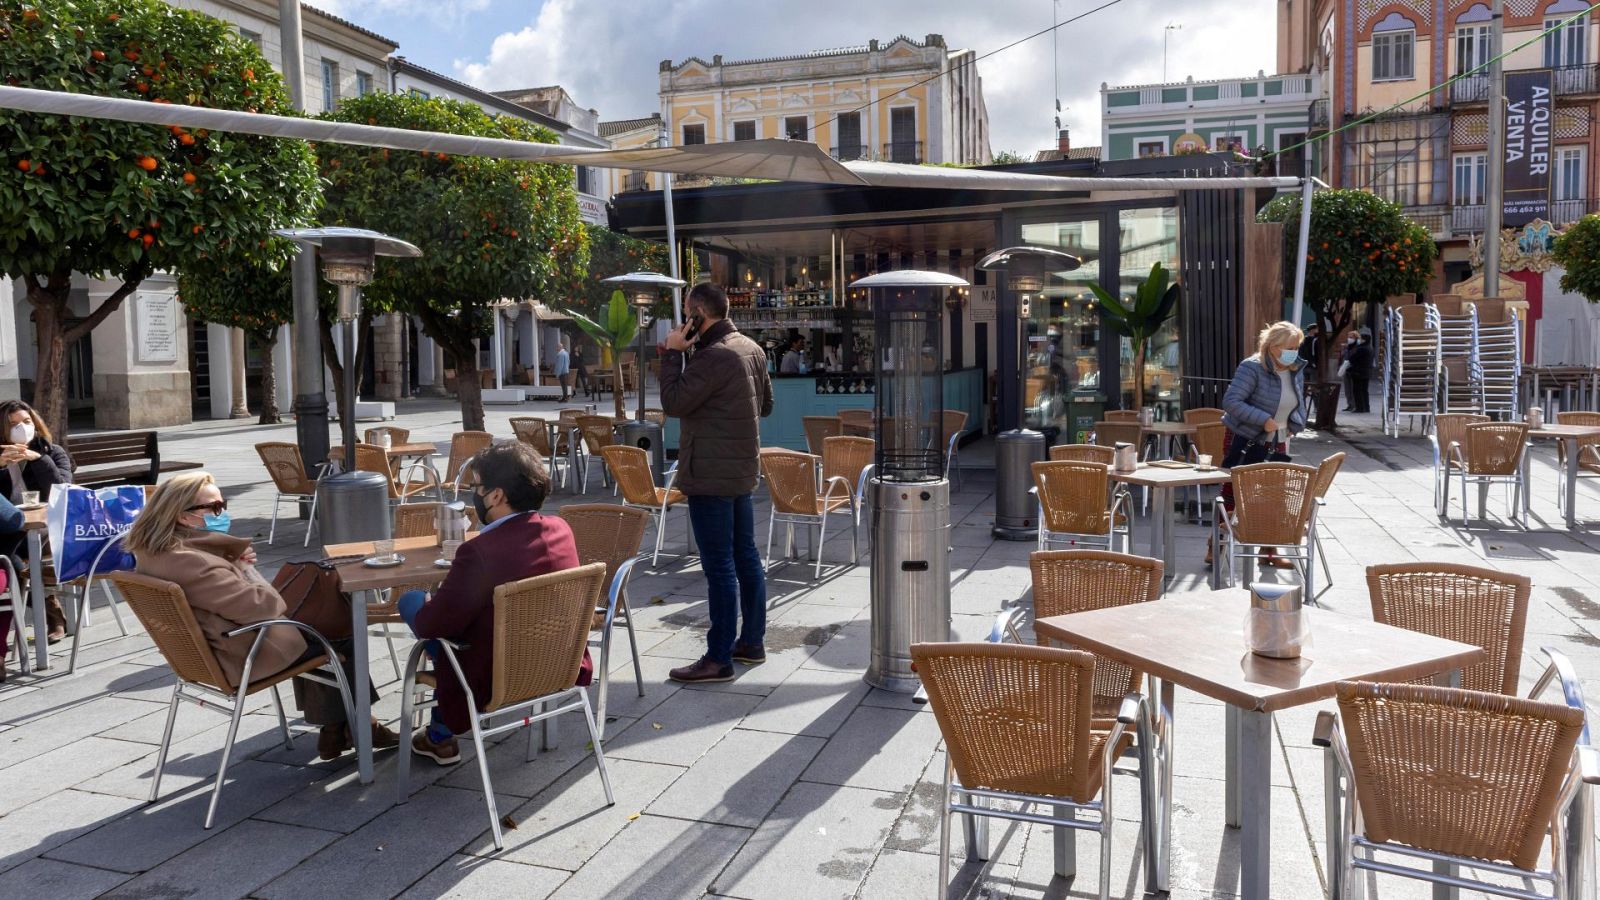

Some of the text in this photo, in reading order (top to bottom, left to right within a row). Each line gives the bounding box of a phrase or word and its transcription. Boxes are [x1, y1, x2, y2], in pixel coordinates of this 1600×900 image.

[1507, 101, 1525, 162] VENTA
[1530, 86, 1549, 175] ALQUILER
[1535, 205, 1546, 213] 911
